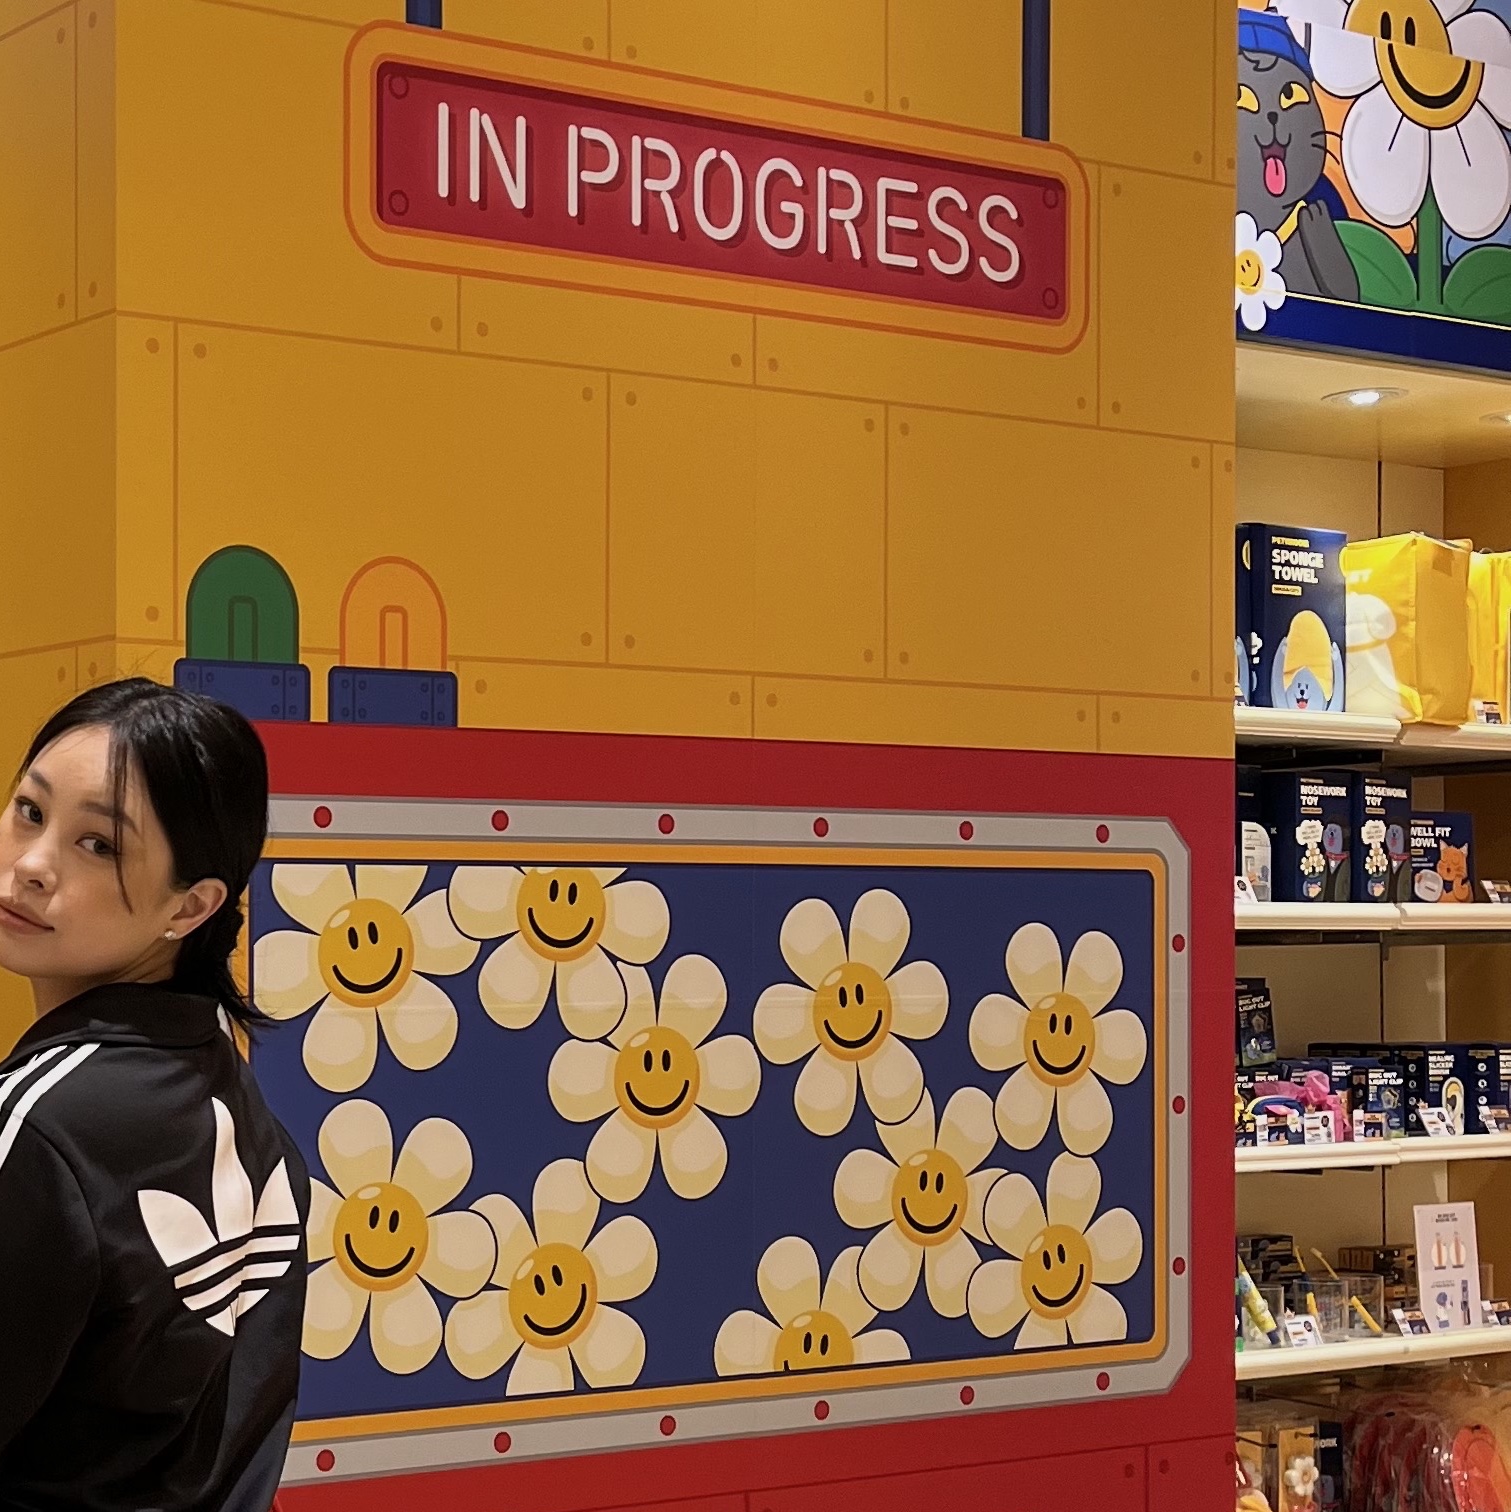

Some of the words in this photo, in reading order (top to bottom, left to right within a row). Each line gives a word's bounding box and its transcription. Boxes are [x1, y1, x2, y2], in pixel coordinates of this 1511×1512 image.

[438, 102, 526, 209] IN
[568, 124, 1021, 282] PROGRESS
[1271, 549, 1324, 568] SPONGE
[1271, 565, 1319, 583] TOWEL
[1300, 785, 1347, 797] NOSEWORK
[1364, 785, 1408, 798] NOSEWORK
[1300, 795, 1319, 806] TOY
[1364, 796, 1383, 806] TOY
[1435, 827, 1452, 837] FIT
